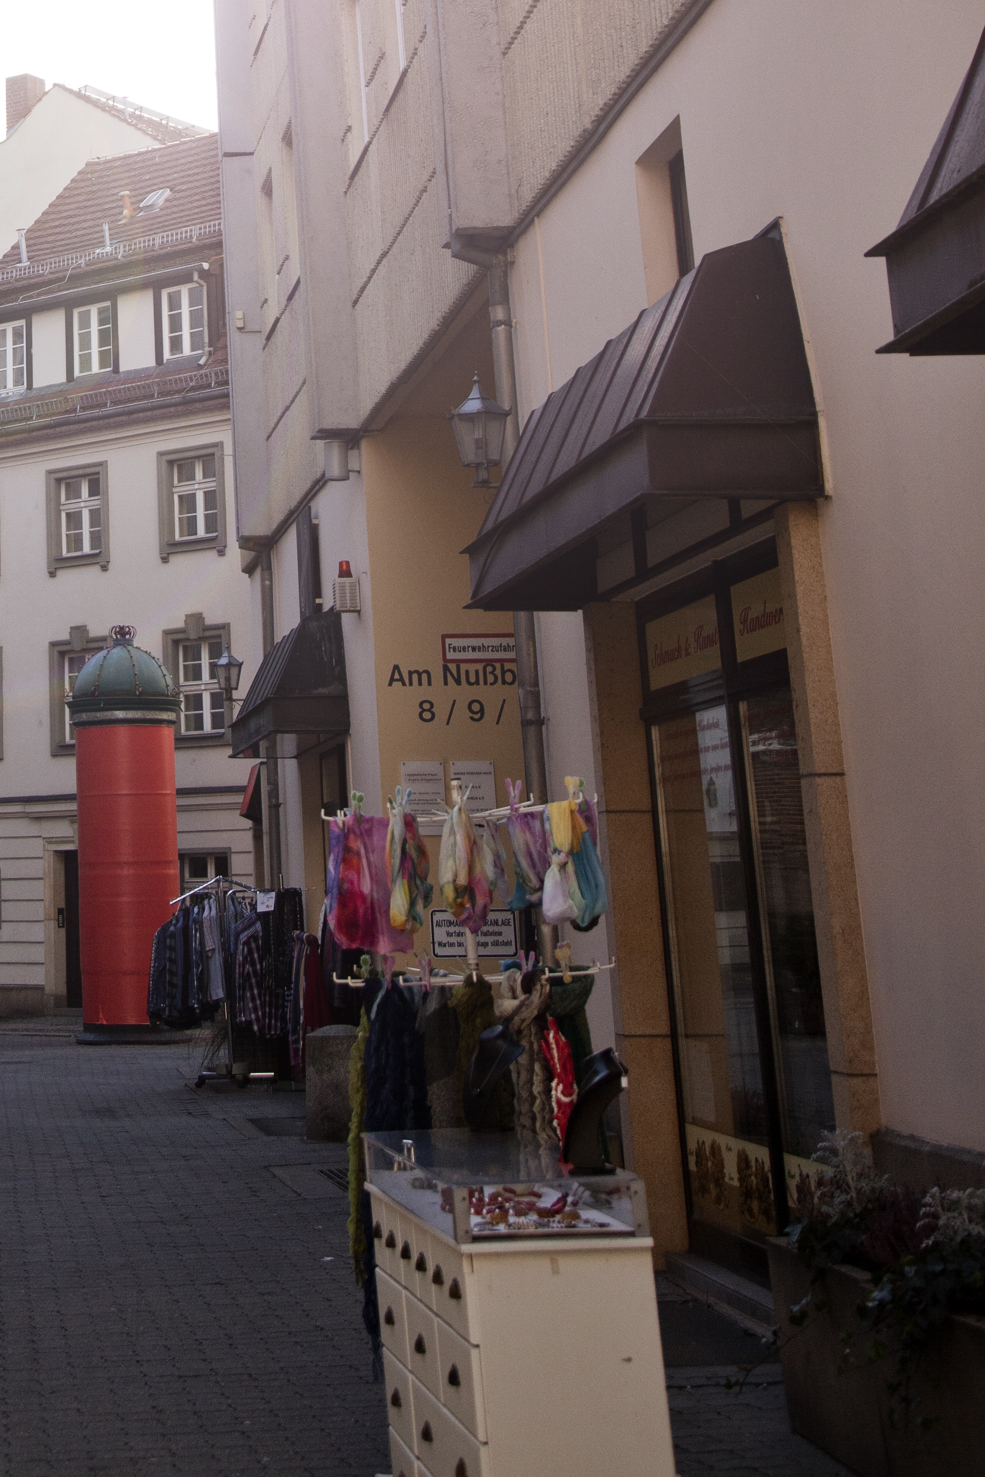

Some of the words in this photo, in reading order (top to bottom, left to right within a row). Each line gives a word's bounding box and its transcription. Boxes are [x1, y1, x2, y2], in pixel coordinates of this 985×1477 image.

[739, 600, 785, 636] Handwer
[447, 643, 516, 653] Feuerwehrzufahr
[651, 635, 682, 669] Schmuck
[684, 636, 691, 657] &
[387, 664, 432, 687] Am
[442, 662, 518, 686] Nußb
[418, 699, 436, 723] 8
[445, 699, 457, 726] /
[467, 699, 485, 722] 9
[495, 698, 507, 726] /
[483, 918, 512, 927] RANLAGE
[445, 929, 466, 938] Vorfahr
[437, 940, 456, 948] Warten
[456, 939, 465, 947] bis
[490, 939, 513, 947] stillsteht
